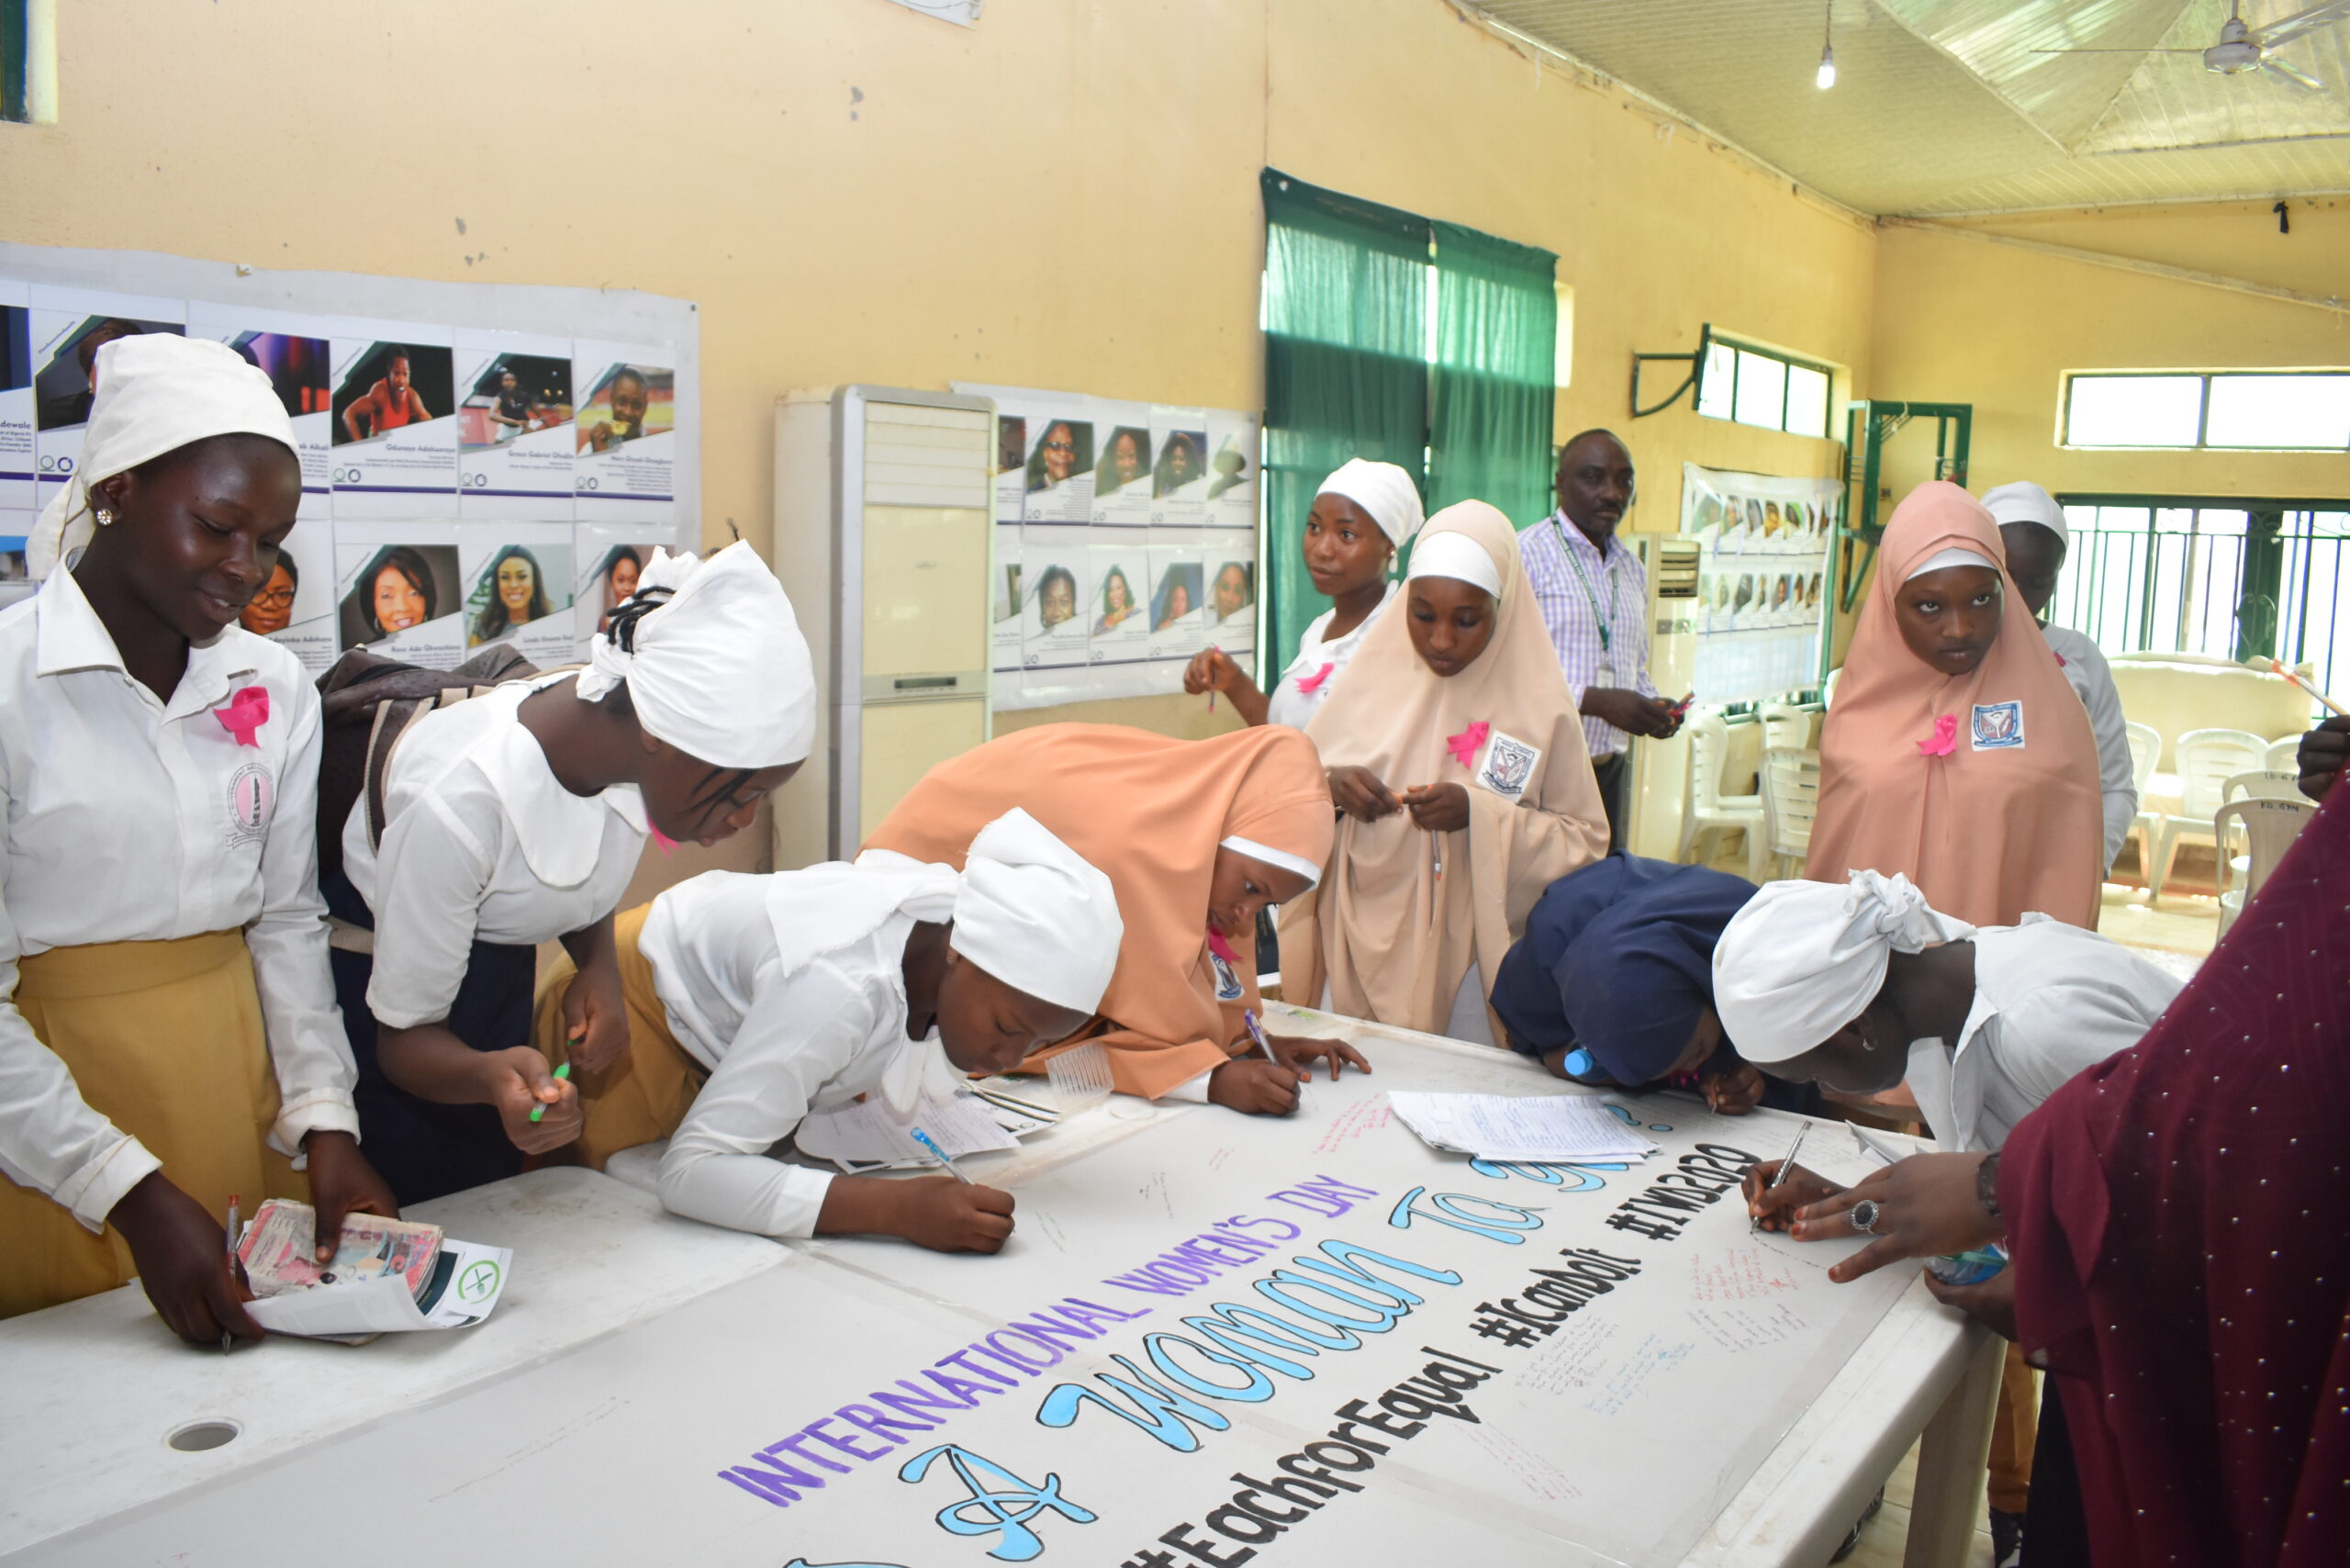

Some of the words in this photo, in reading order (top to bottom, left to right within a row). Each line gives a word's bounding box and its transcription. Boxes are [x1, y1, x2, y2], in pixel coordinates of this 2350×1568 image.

[0, 420, 31, 429] dewale
[1605, 1143, 1763, 1242] #IWD2020
[718, 1297, 1153, 1507] INTERNATIONAL
[1103, 1215, 1301, 1296] WOMEN'S
[1266, 1174, 1380, 1218] DAY
[898, 1443, 1098, 1562] A
